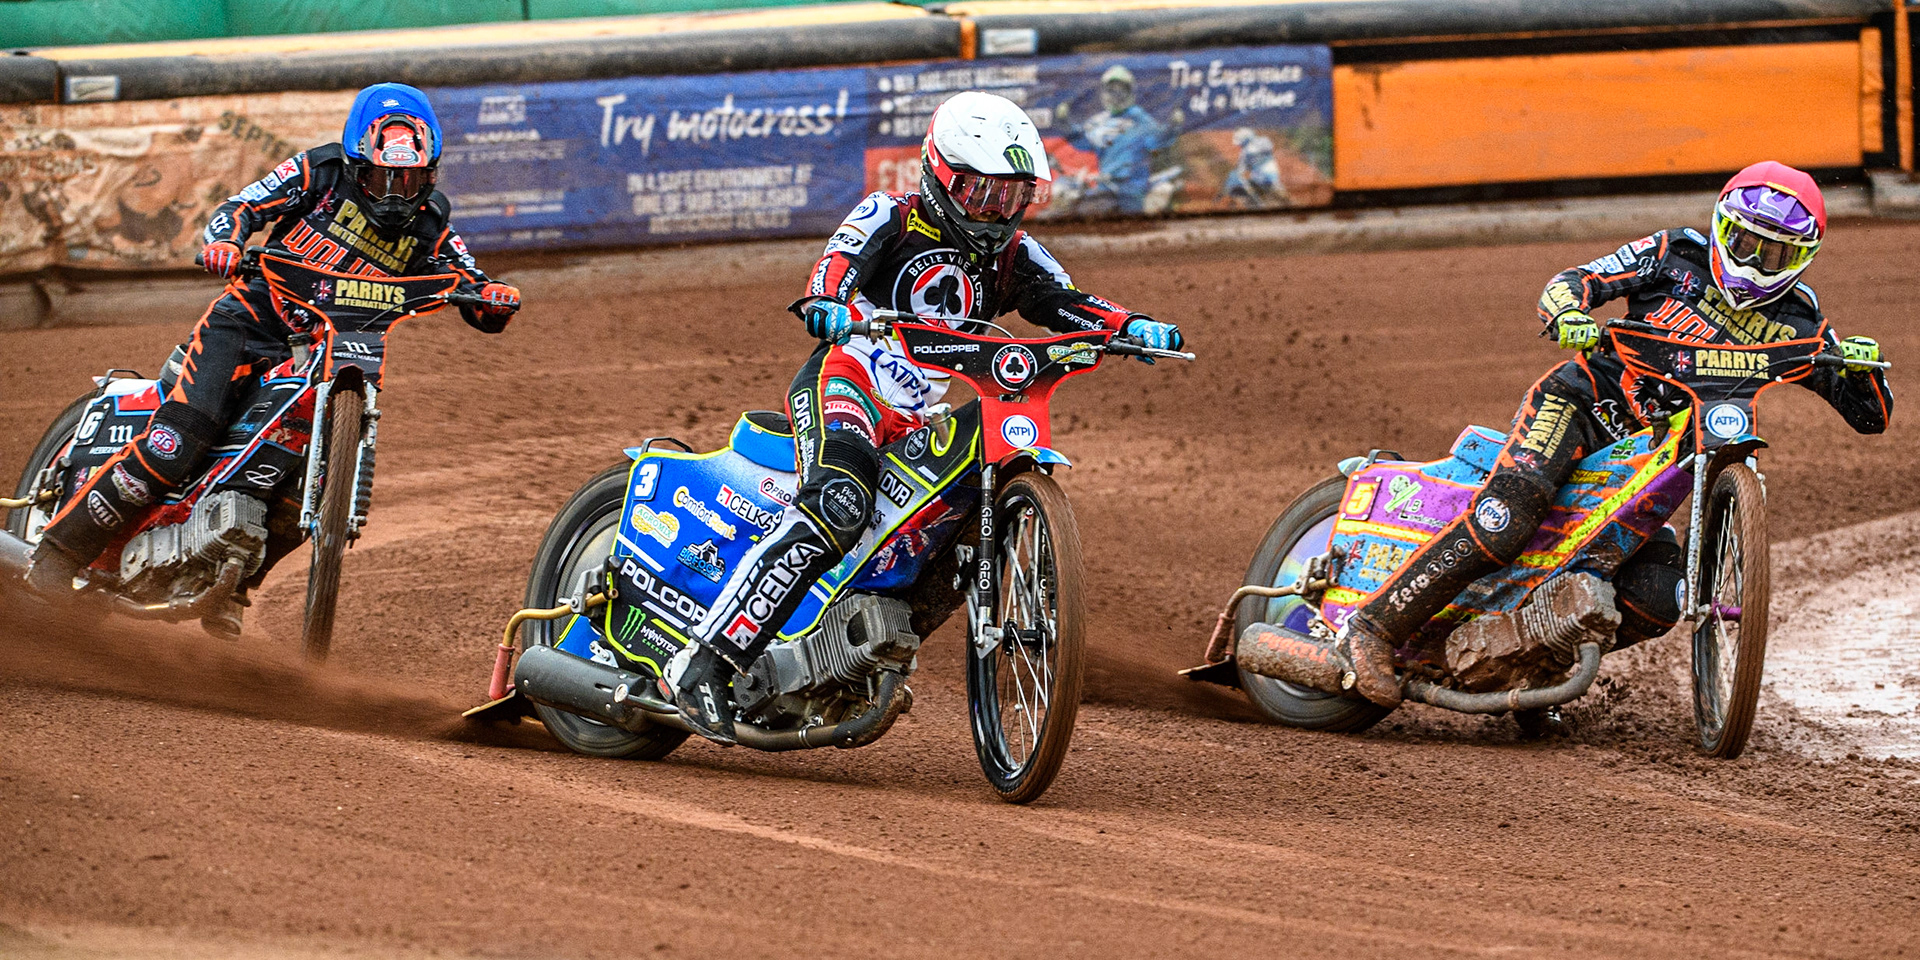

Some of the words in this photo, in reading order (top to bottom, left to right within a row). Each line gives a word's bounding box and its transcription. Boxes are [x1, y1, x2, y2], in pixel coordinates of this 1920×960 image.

[597, 94, 655, 155] Try
[667, 88, 849, 144] motocross!
[332, 198, 419, 264] PAYS
[335, 279, 406, 306] PARRYS
[908, 254, 944, 277] BELLE
[948, 253, 972, 272] VUE
[970, 274, 982, 307] ACES
[913, 343, 981, 355] POLCOPPER
[1695, 350, 1770, 372] PARRYS
[78, 411, 104, 440] 6
[793, 391, 812, 433] DVR
[1713, 415, 1740, 429] ATPI
[153, 432, 173, 451] STS
[1008, 425, 1031, 437] ATPI
[634, 463, 659, 497] 3
[841, 486, 857, 503] FIGA
[880, 472, 911, 507] DVR
[676, 489, 736, 540] ComfortRent
[729, 494, 774, 528] CELKA
[1344, 483, 1377, 515] 5
[636, 508, 673, 538] AGROMIX
[981, 507, 993, 537] GEO
[680, 546, 721, 577] BIGFOOT
[979, 560, 991, 590] GEO
[745, 542, 825, 624] CELKA
[640, 625, 679, 656] MONSTER
